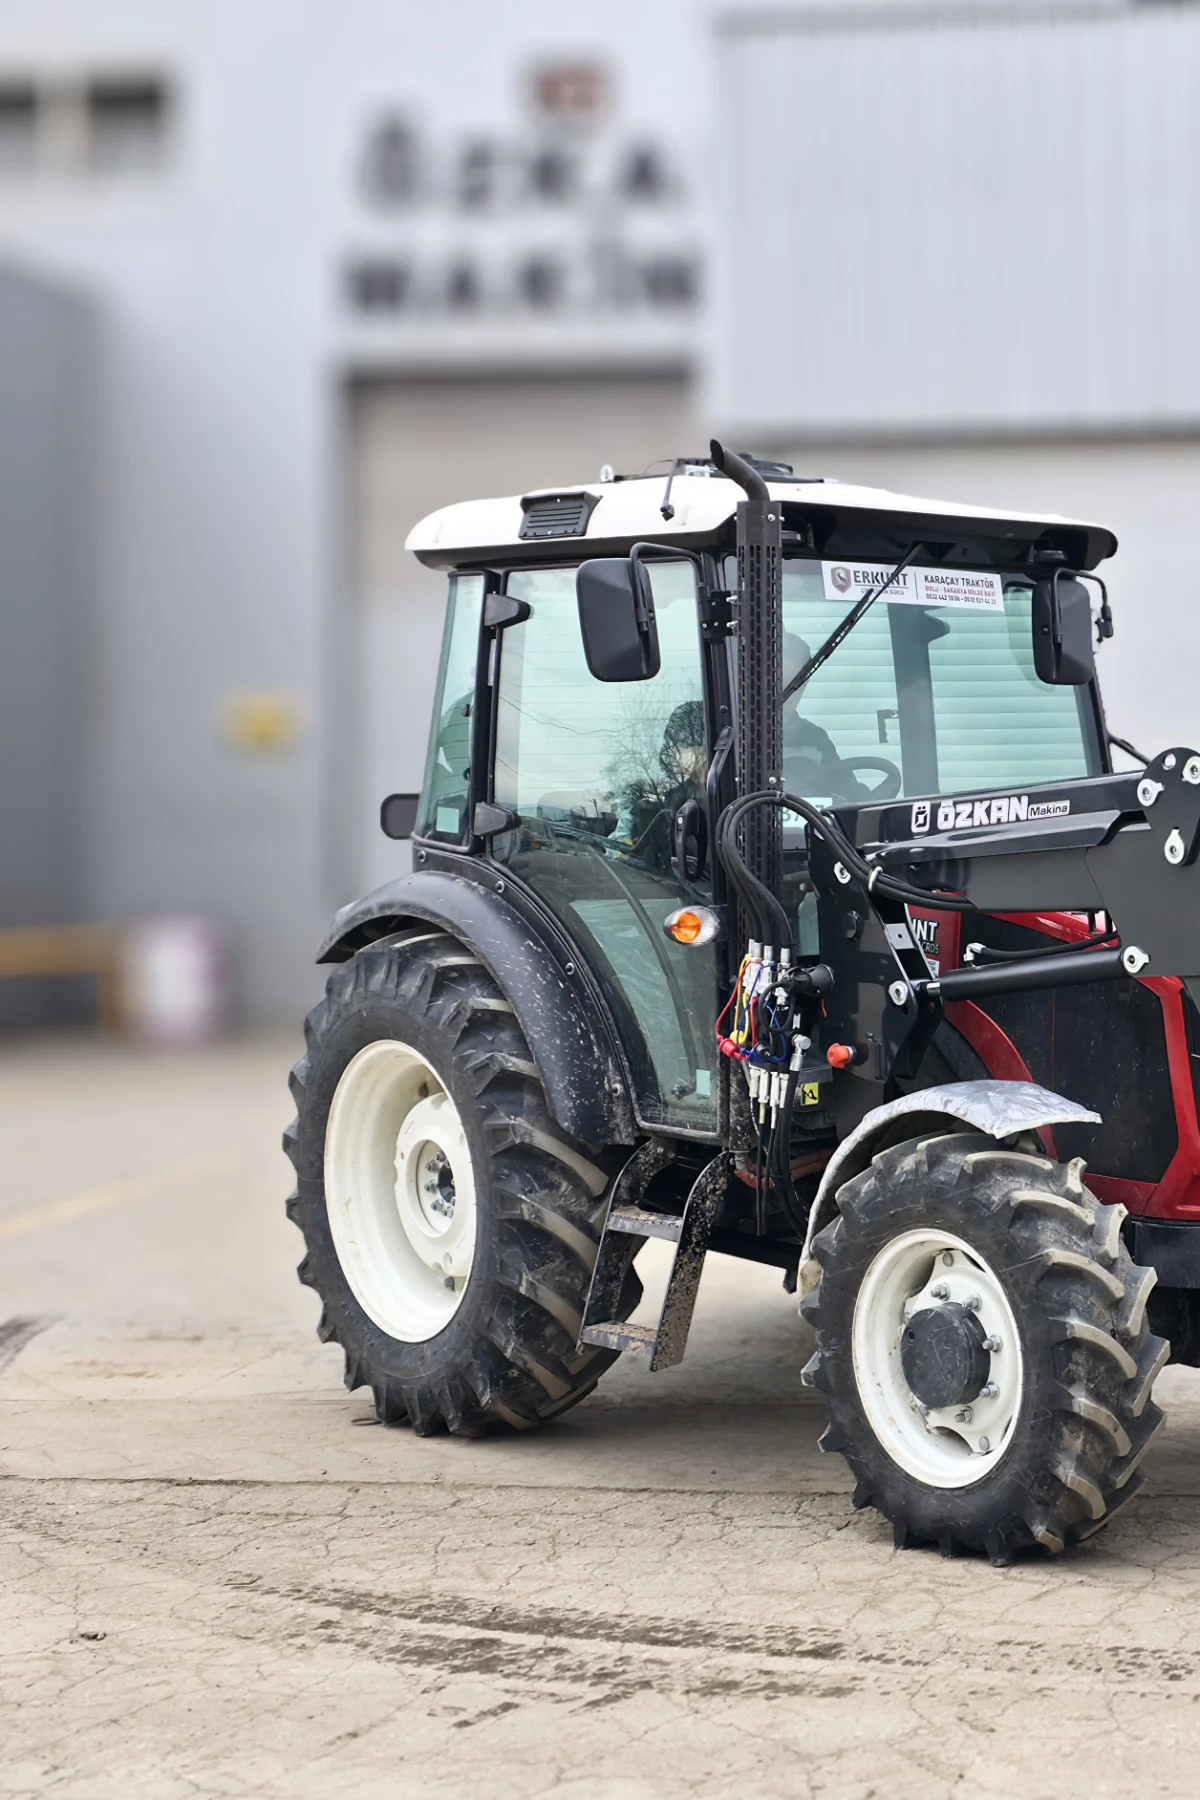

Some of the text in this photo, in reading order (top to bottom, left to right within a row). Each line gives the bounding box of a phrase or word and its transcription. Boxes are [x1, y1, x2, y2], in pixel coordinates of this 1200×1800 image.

[924, 575, 994, 589] KARAÇAY TRAKTÖR
[937, 796, 1028, 829] ÖZKAN
[1030, 803, 1068, 817] Makina
